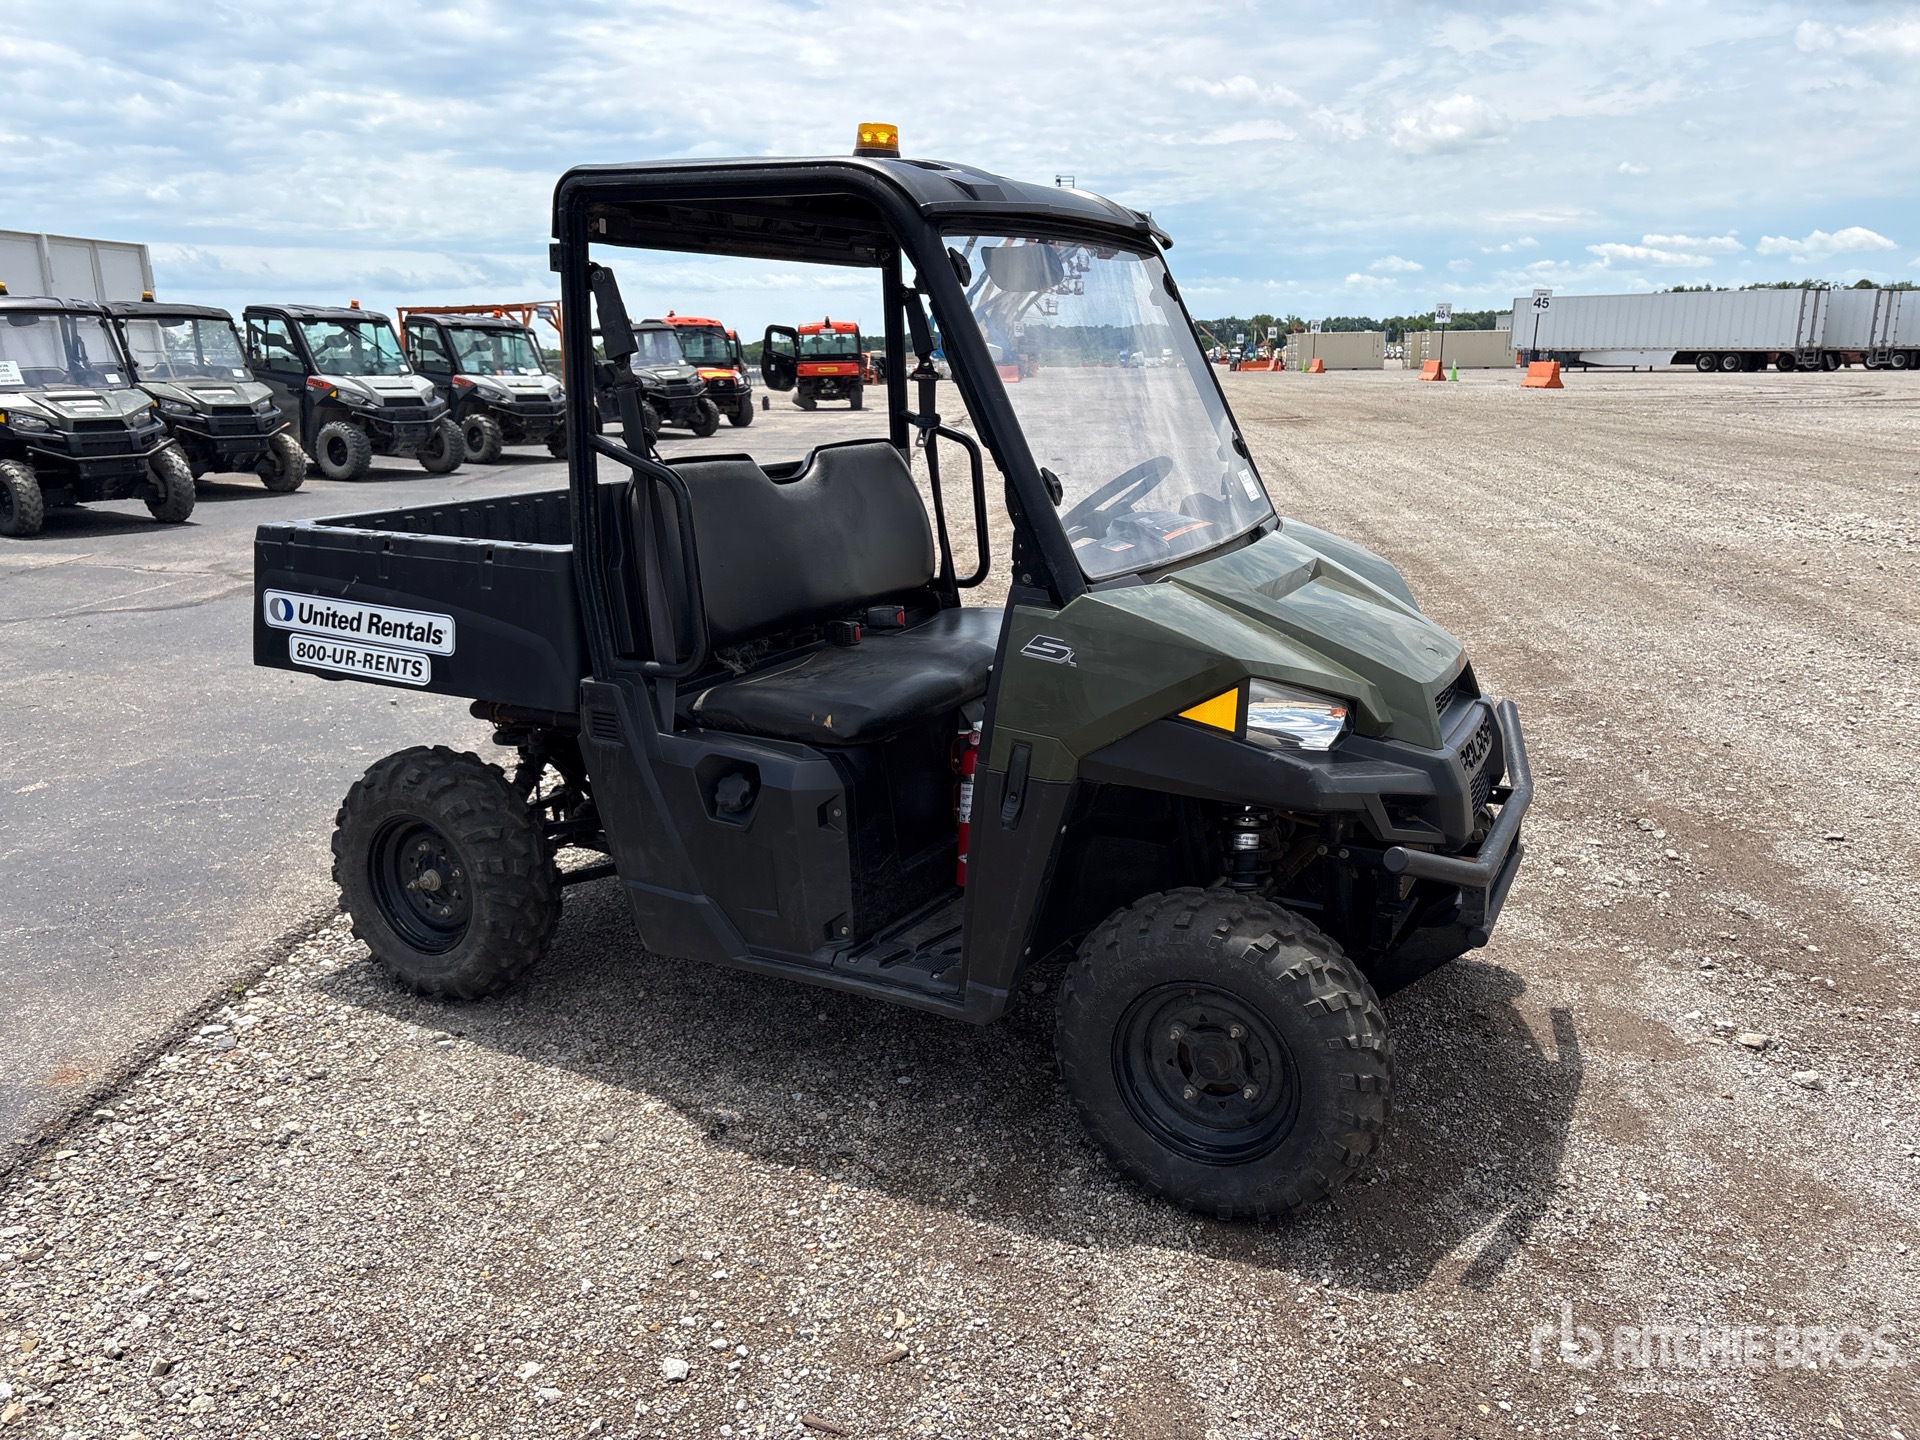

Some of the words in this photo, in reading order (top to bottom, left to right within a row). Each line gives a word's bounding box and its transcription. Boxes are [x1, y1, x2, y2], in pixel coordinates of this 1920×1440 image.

[1533, 297, 1549, 308] 45
[1436, 309, 1446, 319] 46
[307, 377, 325, 387] PRO
[299, 602, 363, 632] United
[367, 612, 444, 646] Rentals
[296, 642, 423, 678] 800-UR-RENTS
